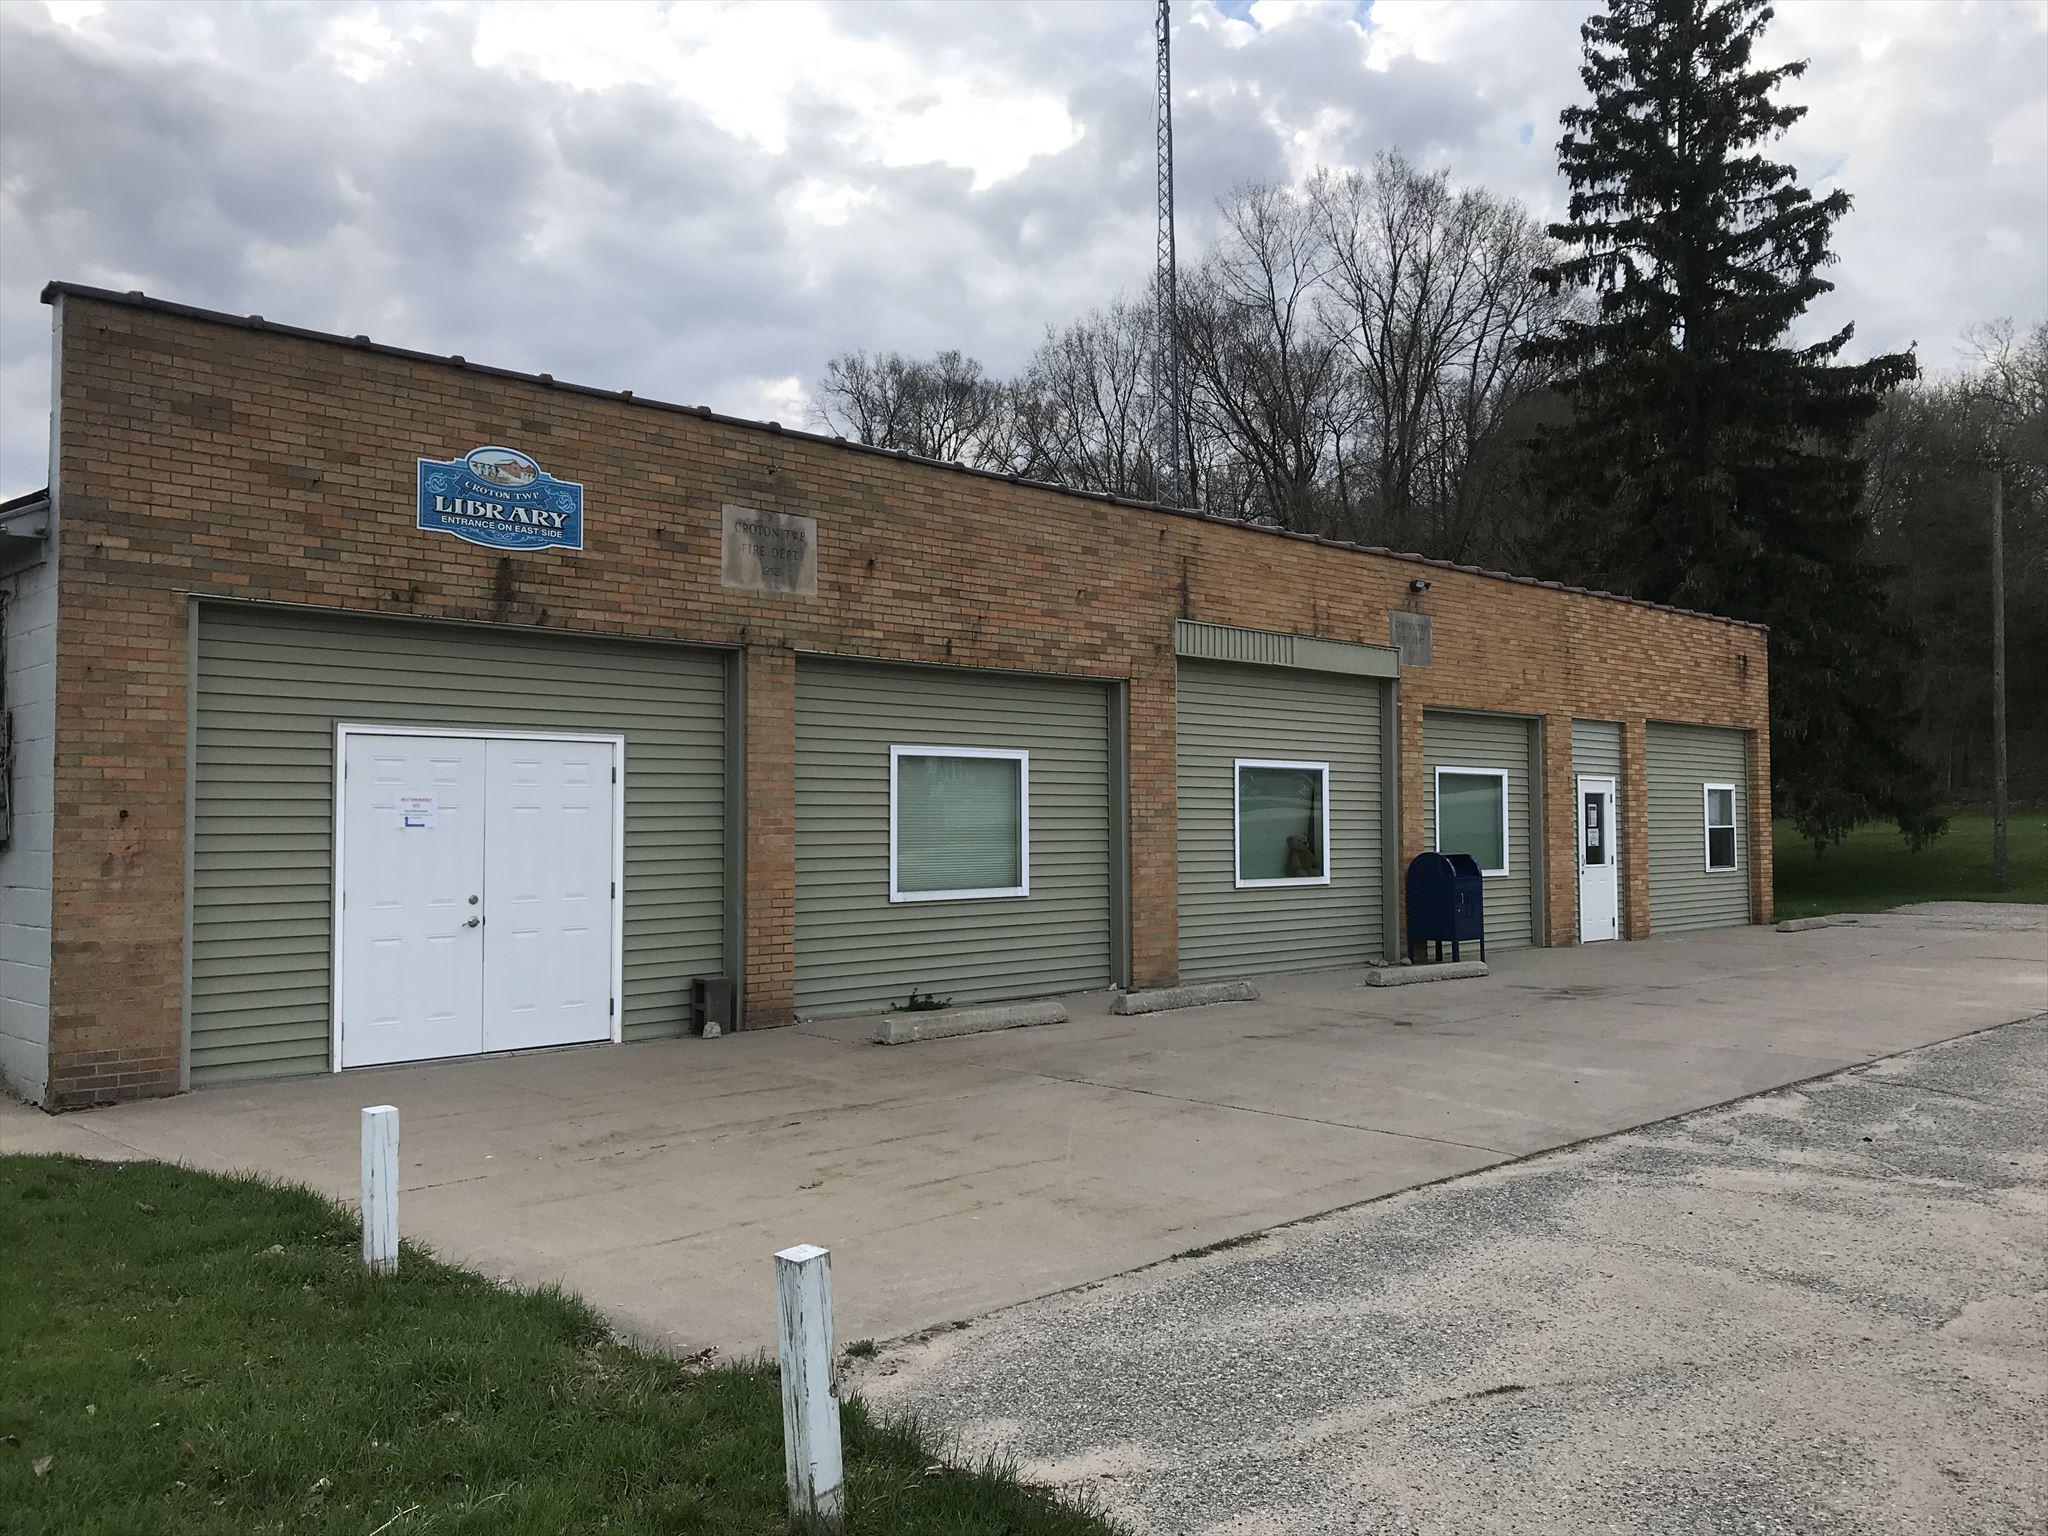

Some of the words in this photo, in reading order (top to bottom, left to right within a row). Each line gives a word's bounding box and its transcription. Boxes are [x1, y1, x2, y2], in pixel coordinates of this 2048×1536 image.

[465, 481, 510, 499] CROTON
[434, 495, 569, 529] LIBRARY
[441, 515, 496, 530] ENTRANCE
[497, 523, 513, 532] ON
[514, 525, 540, 536] EAST
[541, 529, 563, 539] SIDE
[735, 522, 778, 537] CROTON
[742, 543, 765, 556] FIRE
